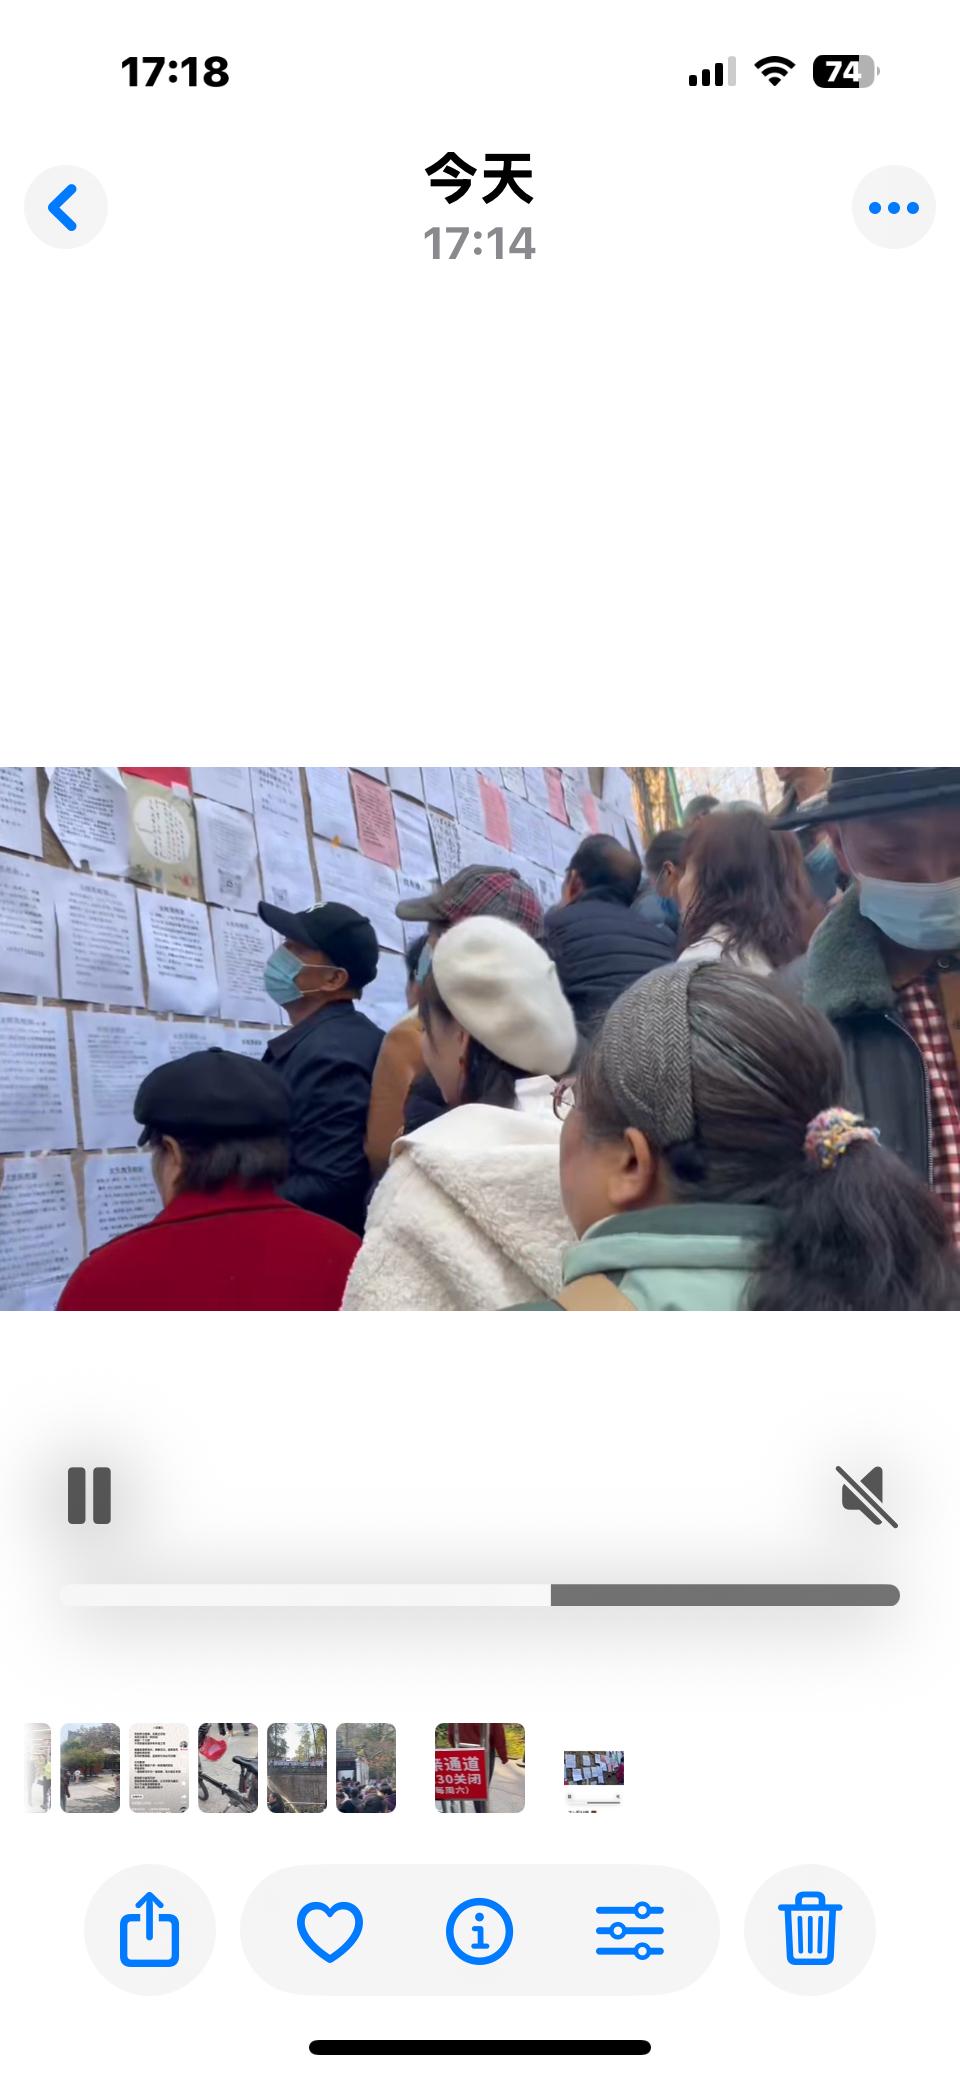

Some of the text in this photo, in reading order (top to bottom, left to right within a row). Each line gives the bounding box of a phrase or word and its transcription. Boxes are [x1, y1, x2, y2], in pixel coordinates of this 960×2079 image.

[122, 56, 229, 87] 17:18
[825, 60, 862, 82] 74
[425, 152, 534, 204] 今天
[425, 227, 535, 259] 17:14
